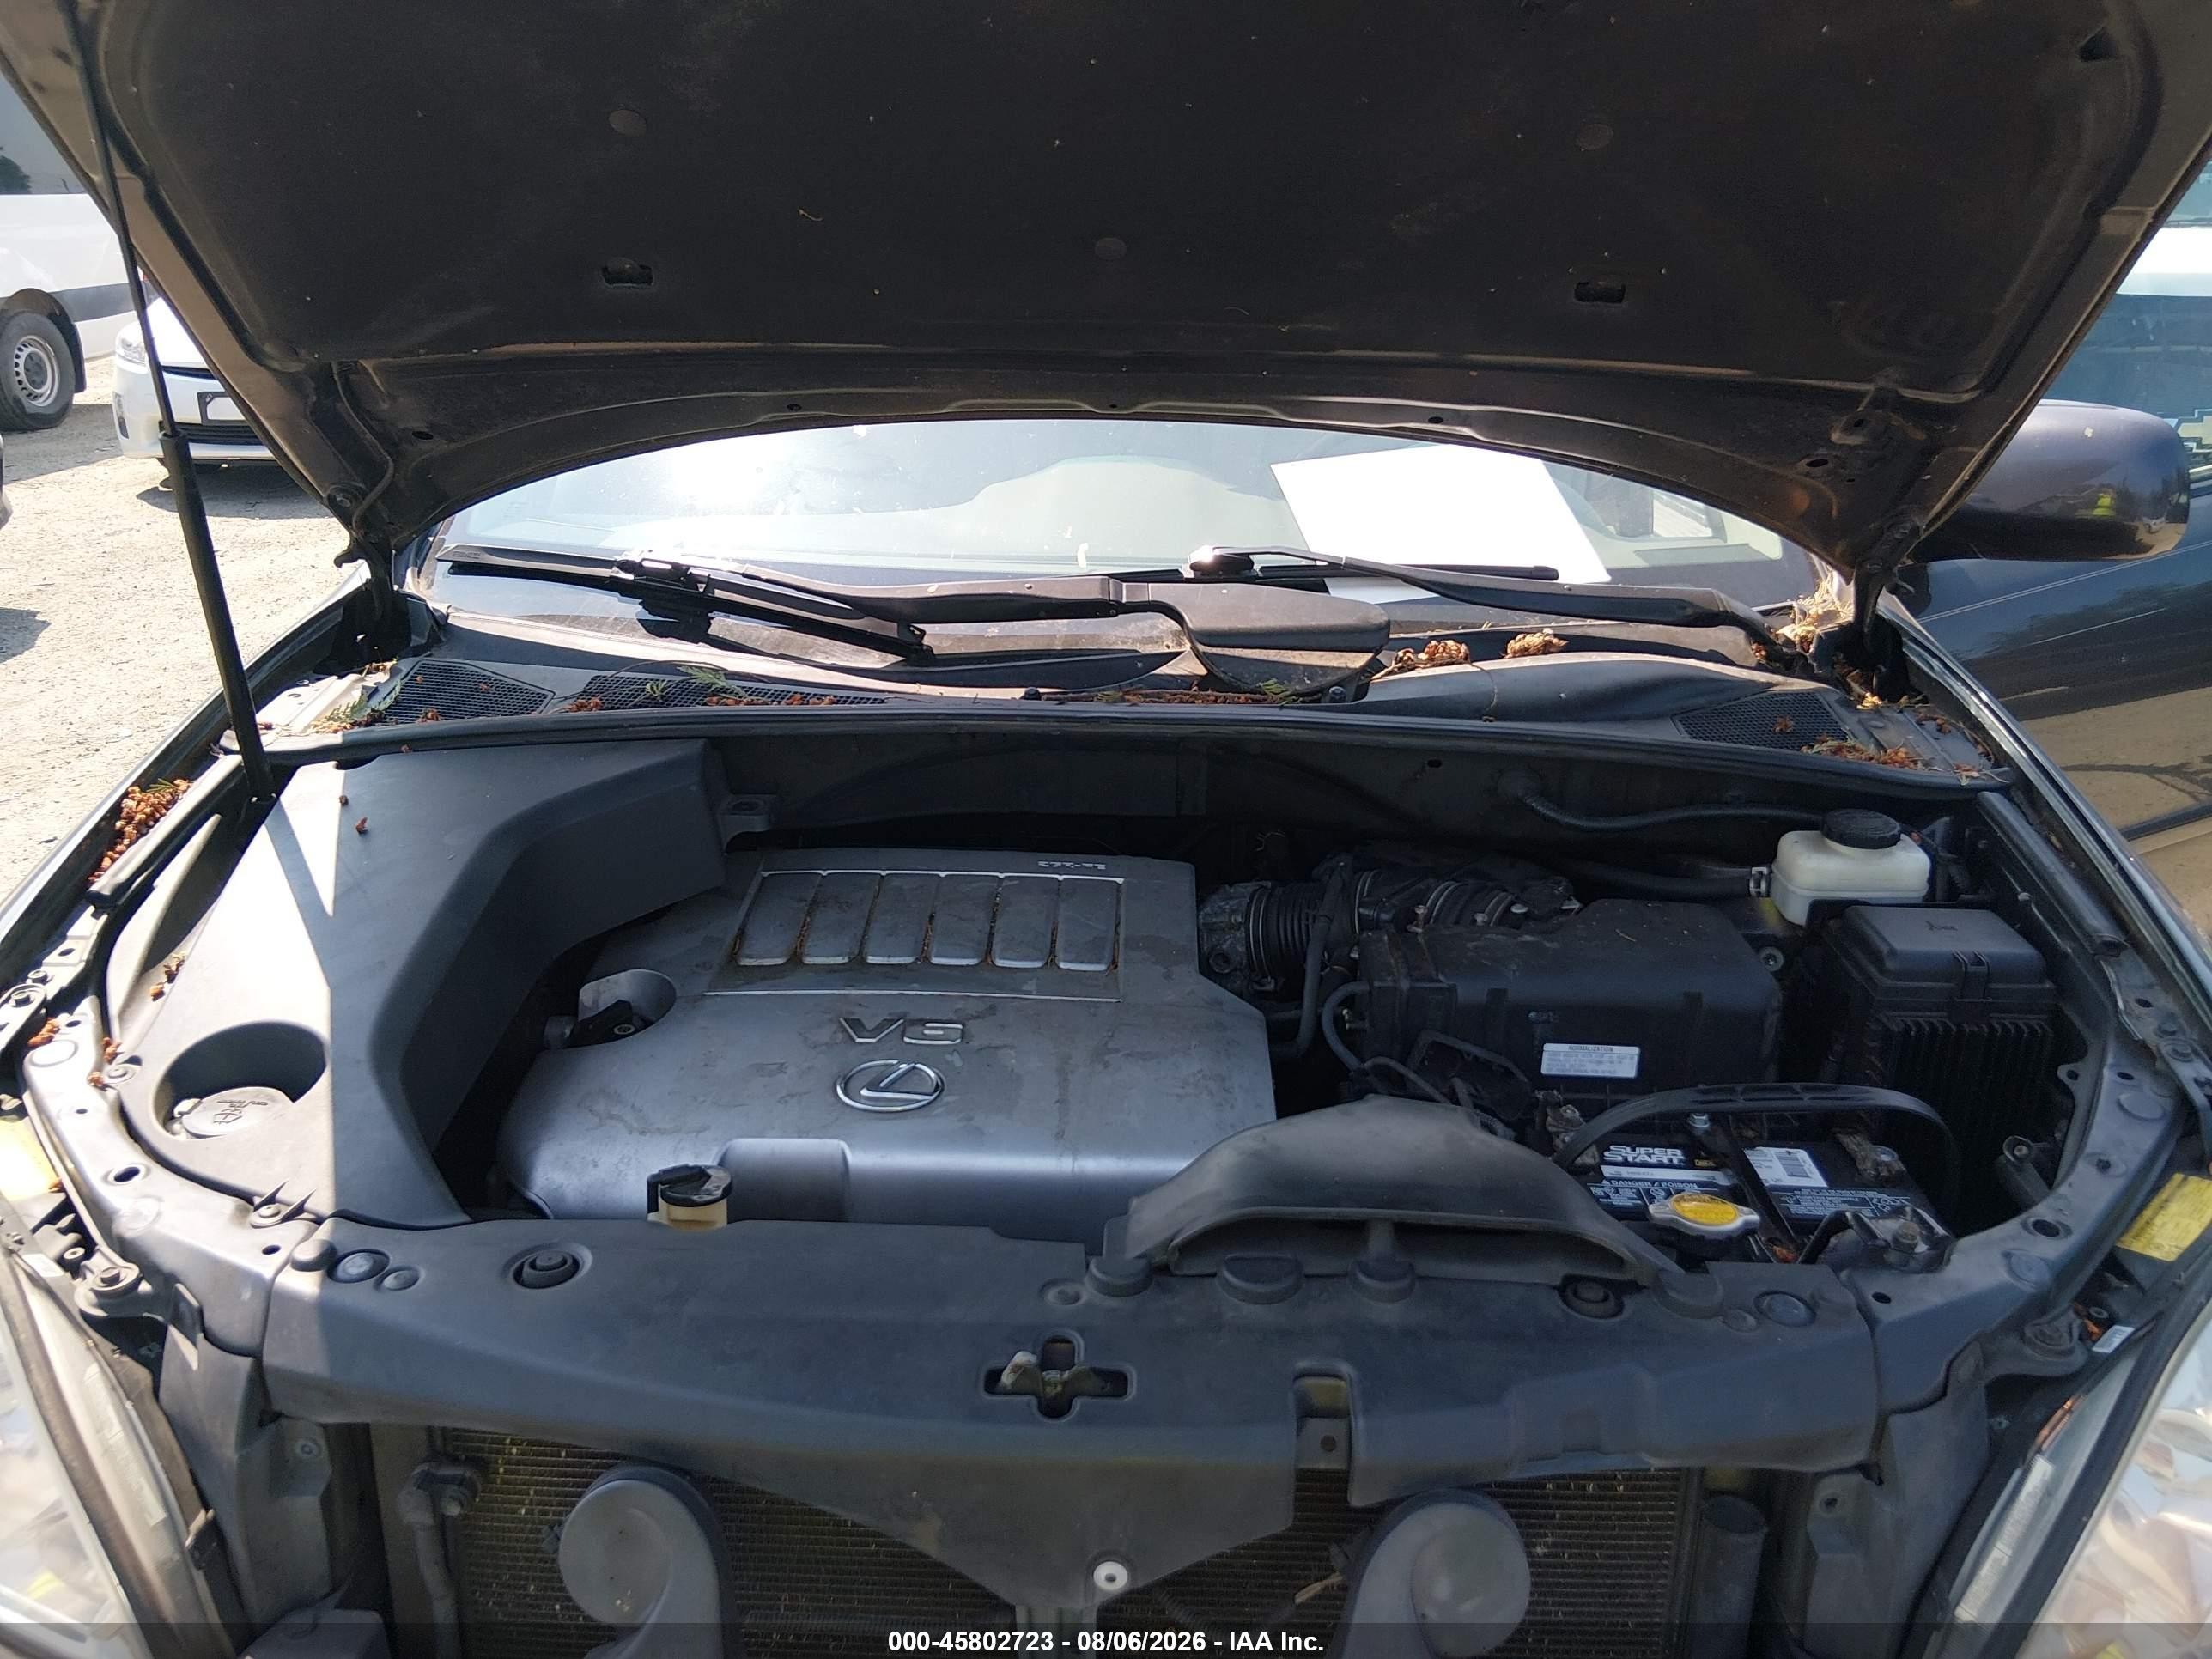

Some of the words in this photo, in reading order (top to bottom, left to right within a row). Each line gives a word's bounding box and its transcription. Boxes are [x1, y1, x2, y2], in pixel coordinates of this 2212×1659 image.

[839, 1017, 963, 1045] V6
[1609, 1145, 1682, 1156] SUPER
[1603, 1152, 1685, 1164] START
